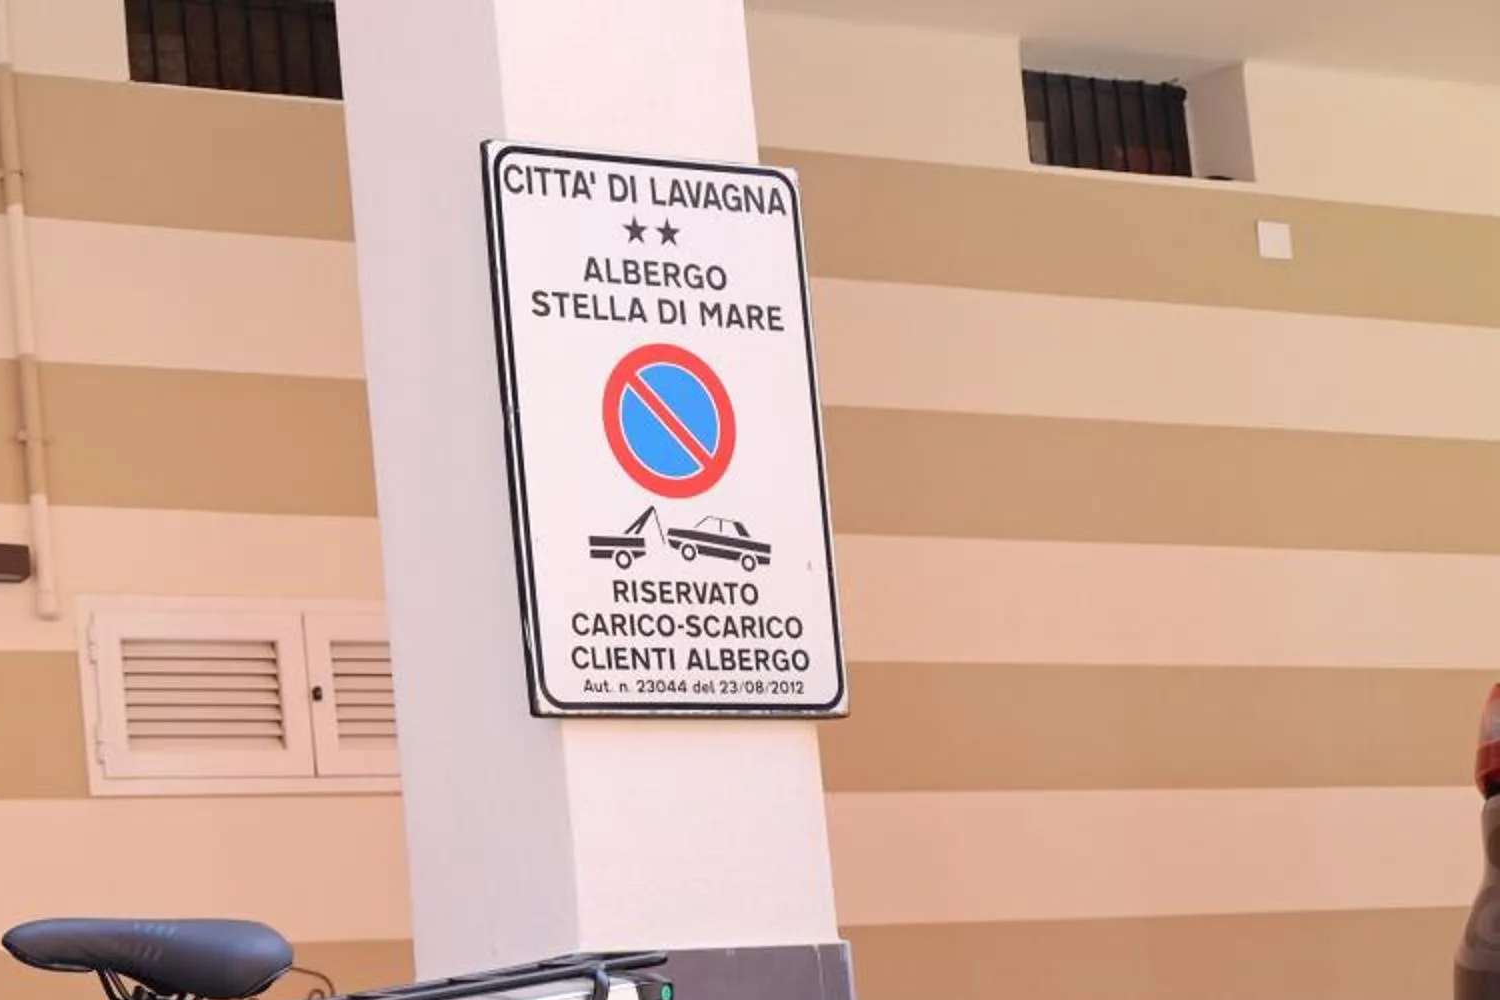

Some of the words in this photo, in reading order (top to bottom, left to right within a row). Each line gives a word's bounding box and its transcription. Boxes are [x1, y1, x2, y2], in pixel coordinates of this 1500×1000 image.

[503, 164, 597, 200] CITTA'
[608, 173, 637, 204] DI
[650, 177, 787, 216] LAVAGNA
[583, 256, 727, 291] ALBERGO
[531, 290, 647, 324] STELLA
[659, 299, 687, 326] DI
[700, 302, 785, 332] MARE
[612, 580, 759, 606] RISERVATO
[571, 612, 803, 639] CARICO-SCARICO
[571, 646, 675, 671] CLIENTI
[686, 648, 810, 673] ALBERGO
[636, 679, 688, 694] 23044
[692, 680, 715, 695] del
[719, 680, 804, 695] 23/08/2012
